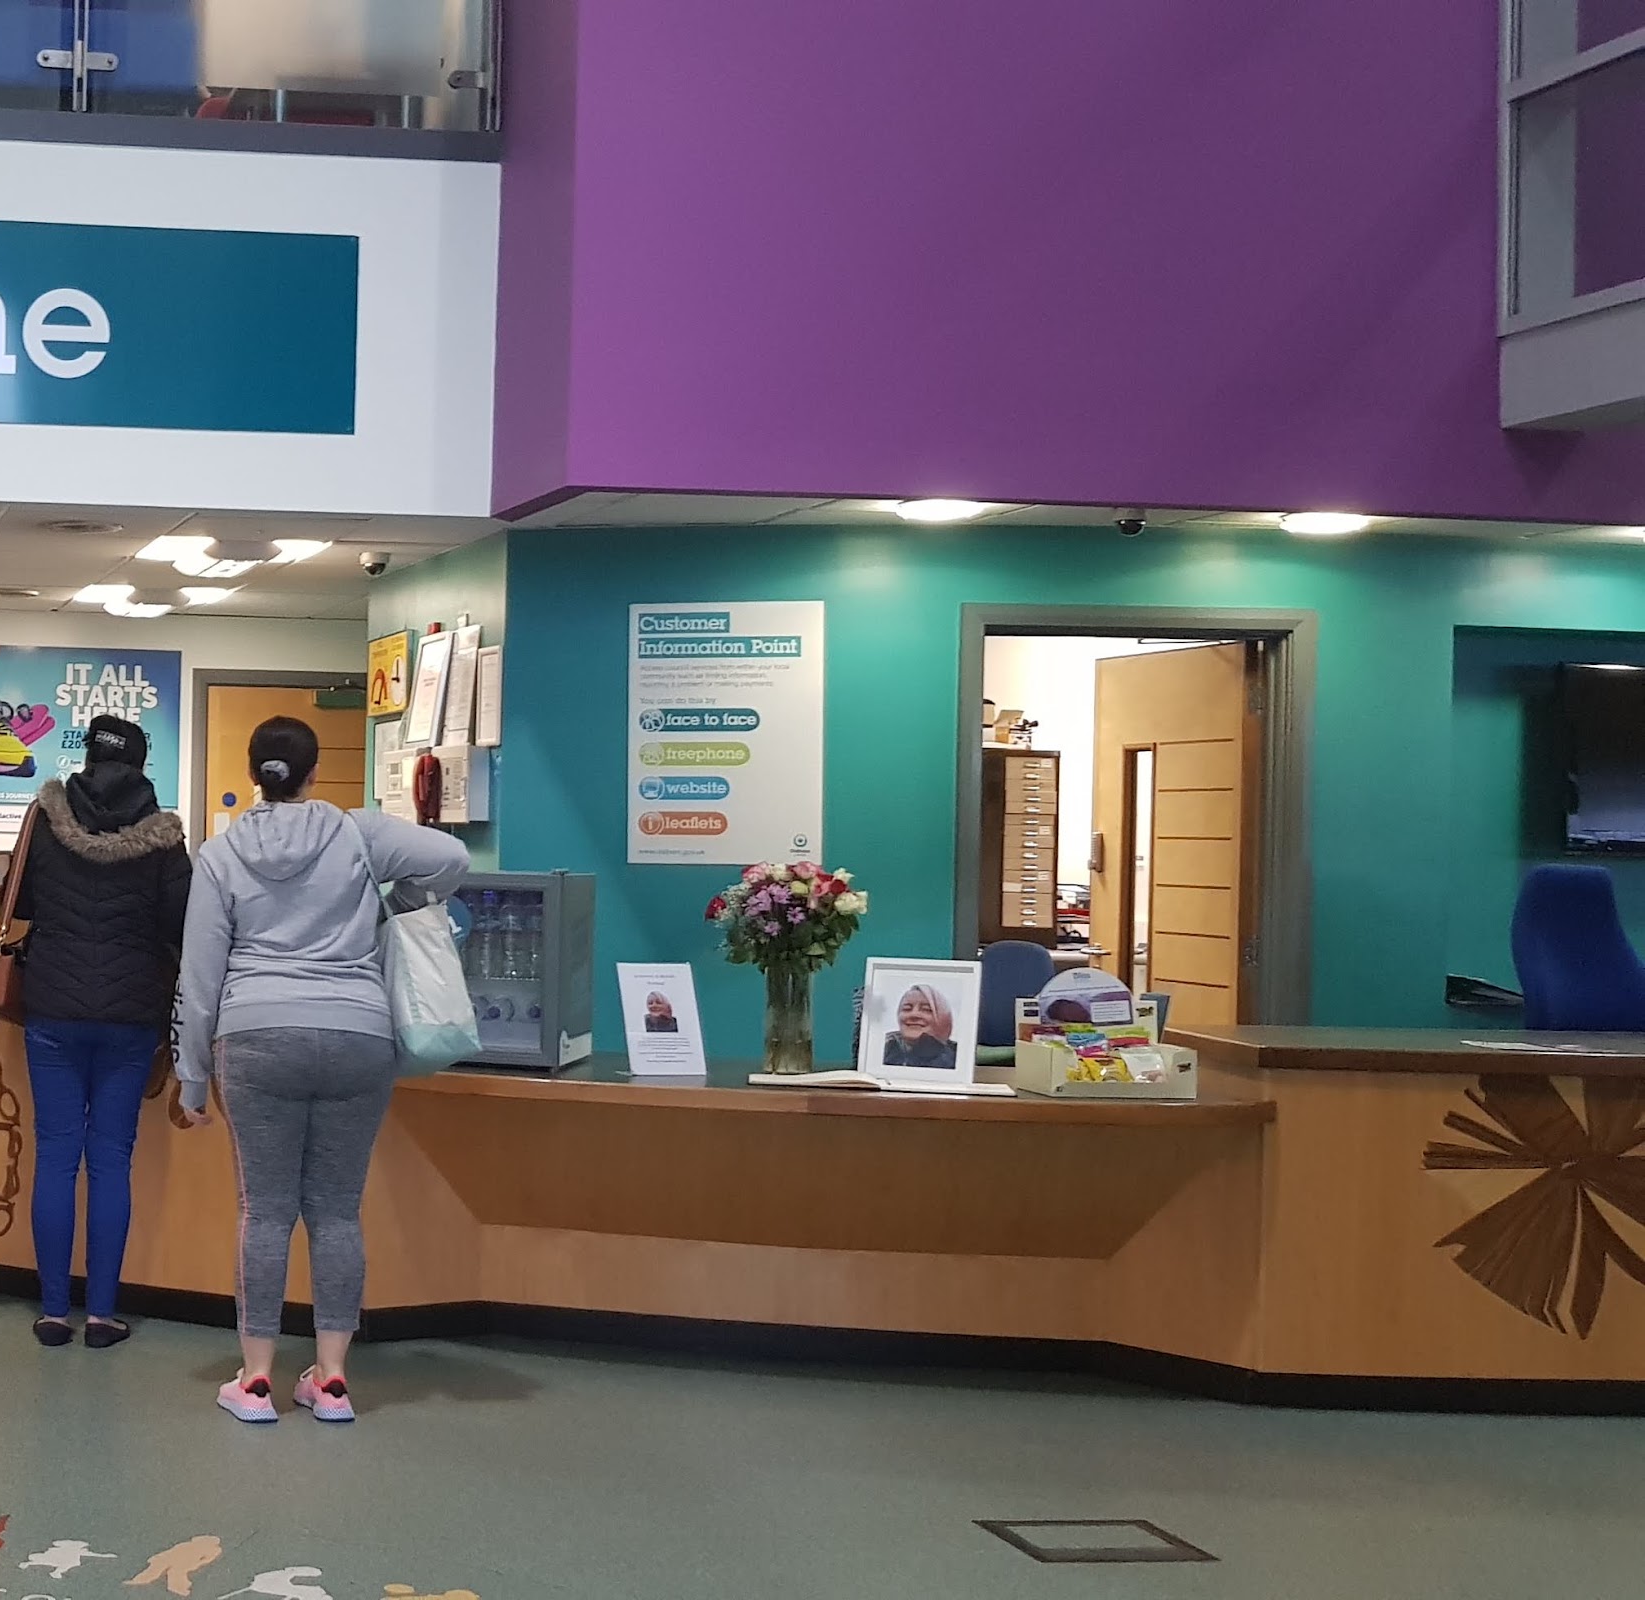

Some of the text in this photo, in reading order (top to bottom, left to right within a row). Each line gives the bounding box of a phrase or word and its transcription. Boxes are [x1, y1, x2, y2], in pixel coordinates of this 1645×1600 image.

[640, 616, 727, 631] Customer
[639, 639, 798, 655] Information Point
[66, 663, 149, 687] IT ALL
[55, 684, 158, 709] STARTS
[665, 713, 757, 726] face to face
[665, 748, 745, 762] freephone
[665, 781, 727, 795] website
[665, 816, 722, 829] leaflets
